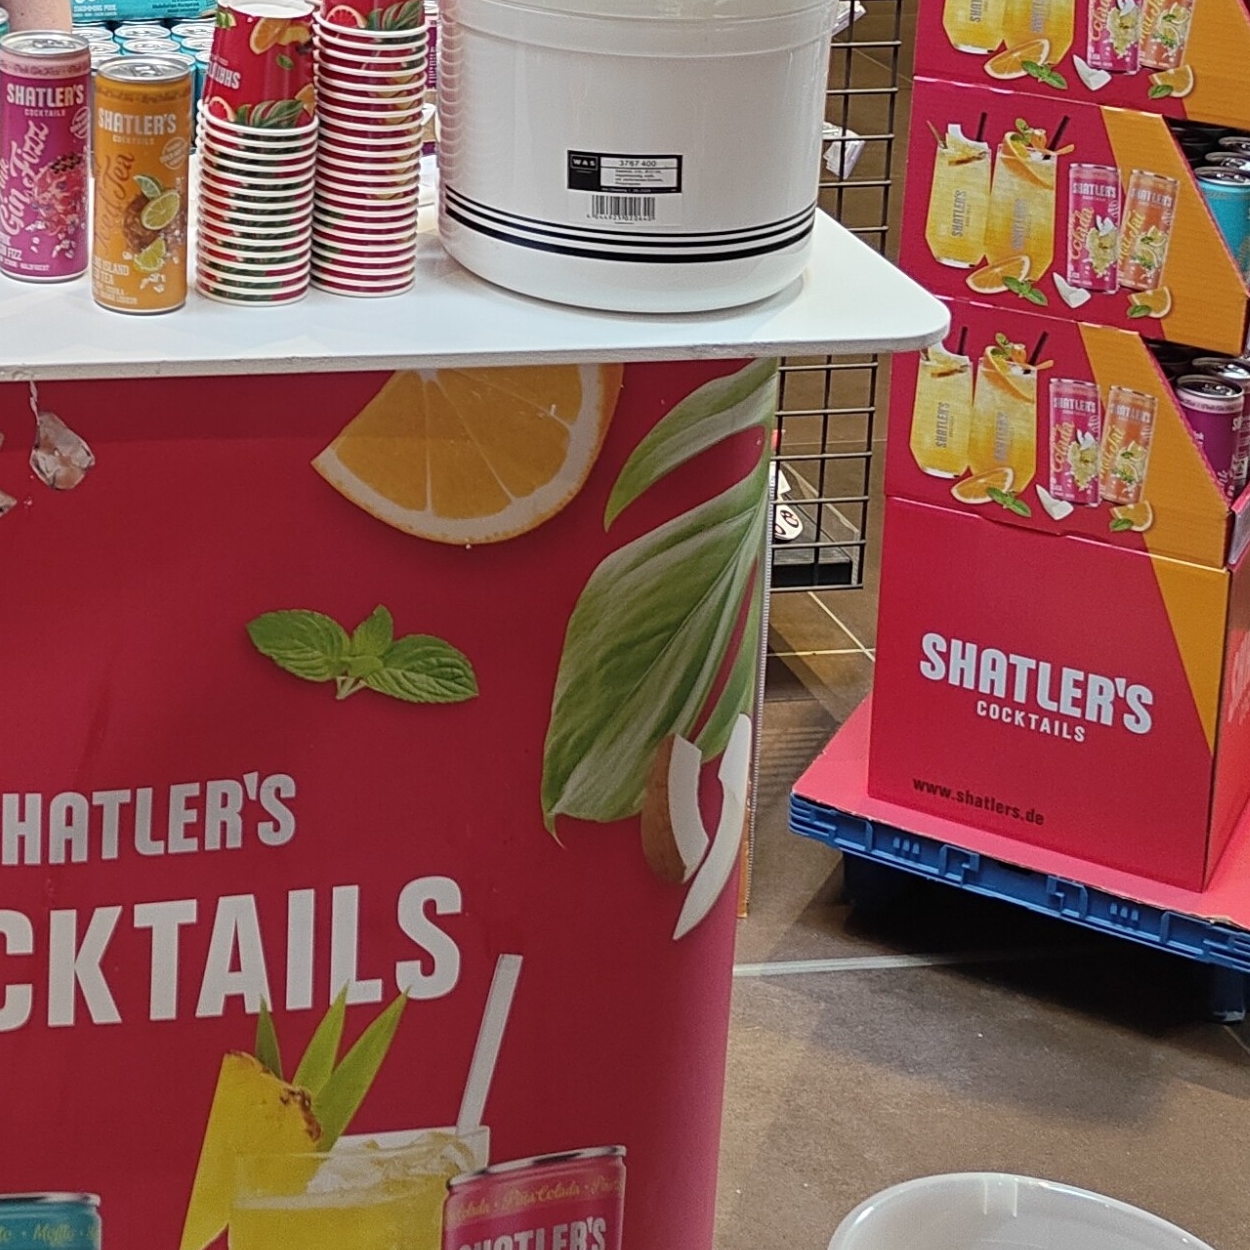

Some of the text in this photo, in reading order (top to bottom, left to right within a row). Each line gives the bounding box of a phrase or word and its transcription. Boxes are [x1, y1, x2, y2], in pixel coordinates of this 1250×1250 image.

[6, 83, 85, 108] SHATLER'S
[97, 106, 178, 135] SHATLER'S
[572, 158, 596, 167] WAS
[918, 631, 1154, 735] SHATLER'S
[976, 700, 1086, 742] COCKTAILS
[912, 777, 1045, 826] www.shatlers.de
[458, 1216, 607, 1250] TLER'S
